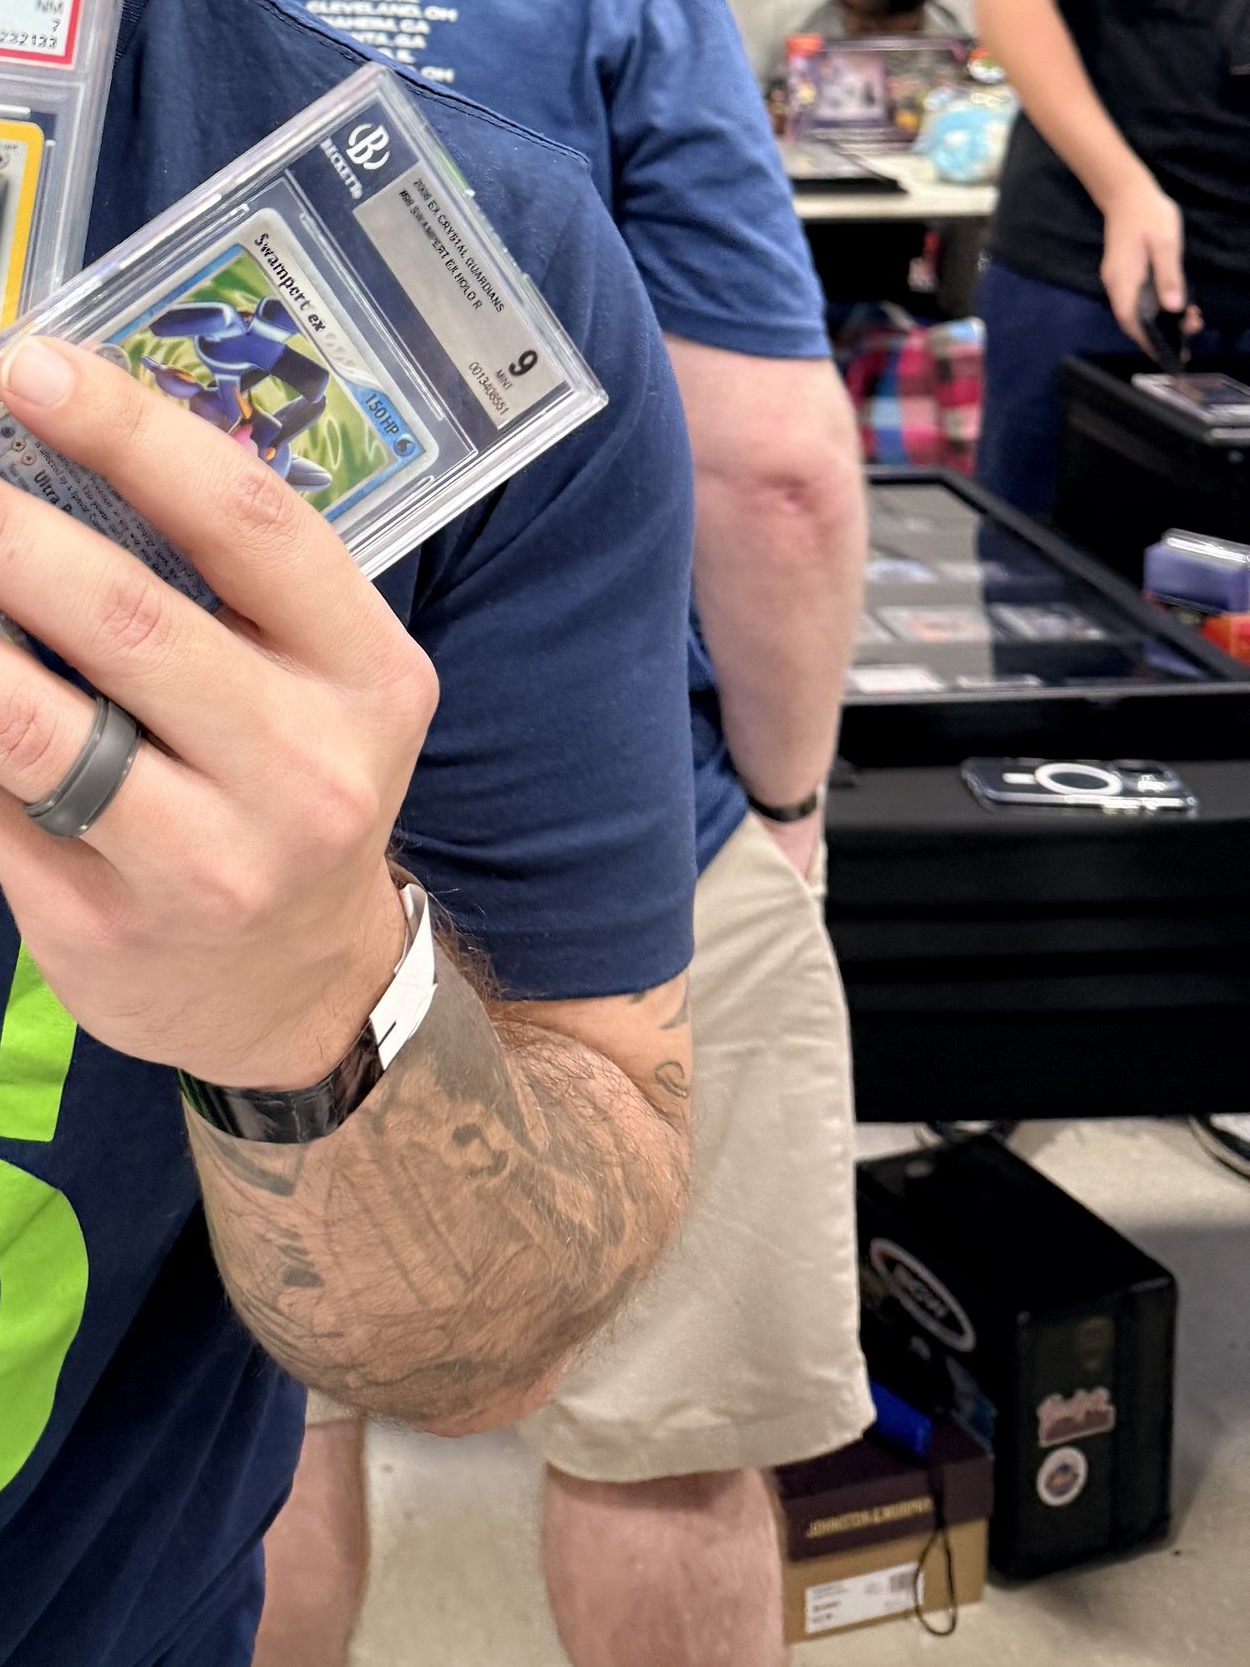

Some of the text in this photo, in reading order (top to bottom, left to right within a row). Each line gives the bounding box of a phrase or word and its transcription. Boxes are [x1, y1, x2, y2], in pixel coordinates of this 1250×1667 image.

[36, 0, 62, 13] NM
[253, 232, 325, 333] Swampert ex
[465, 259, 505, 313] GUARDIANS
[494, 370, 512, 389] MINT
[505, 349, 541, 378] 9
[34, 469, 60, 505] Ultra
